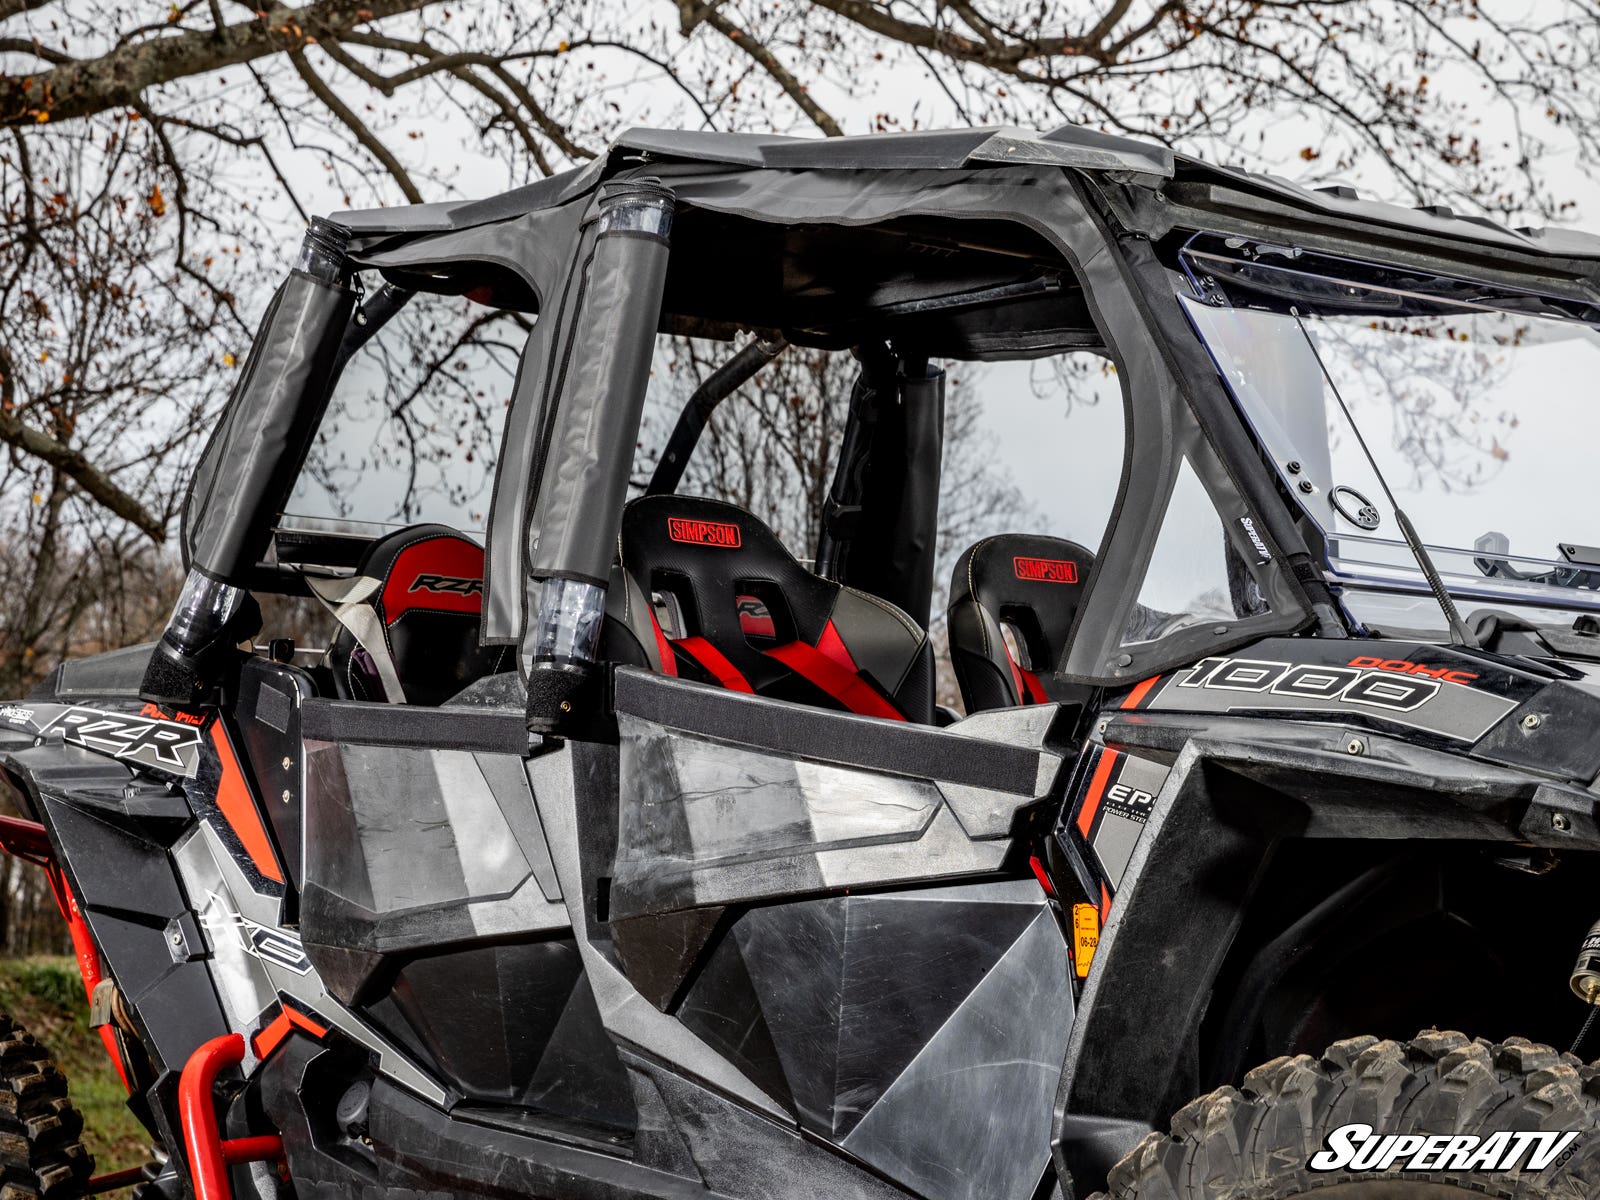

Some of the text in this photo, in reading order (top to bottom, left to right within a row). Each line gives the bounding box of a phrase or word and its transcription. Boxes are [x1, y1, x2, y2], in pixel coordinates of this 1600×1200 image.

[673, 520, 736, 545] SIMPSON
[1017, 560, 1074, 581] SIMPSON
[1178, 656, 1442, 713] 1000
[1347, 656, 1479, 685] DOHC
[40, 706, 203, 768] RZR
